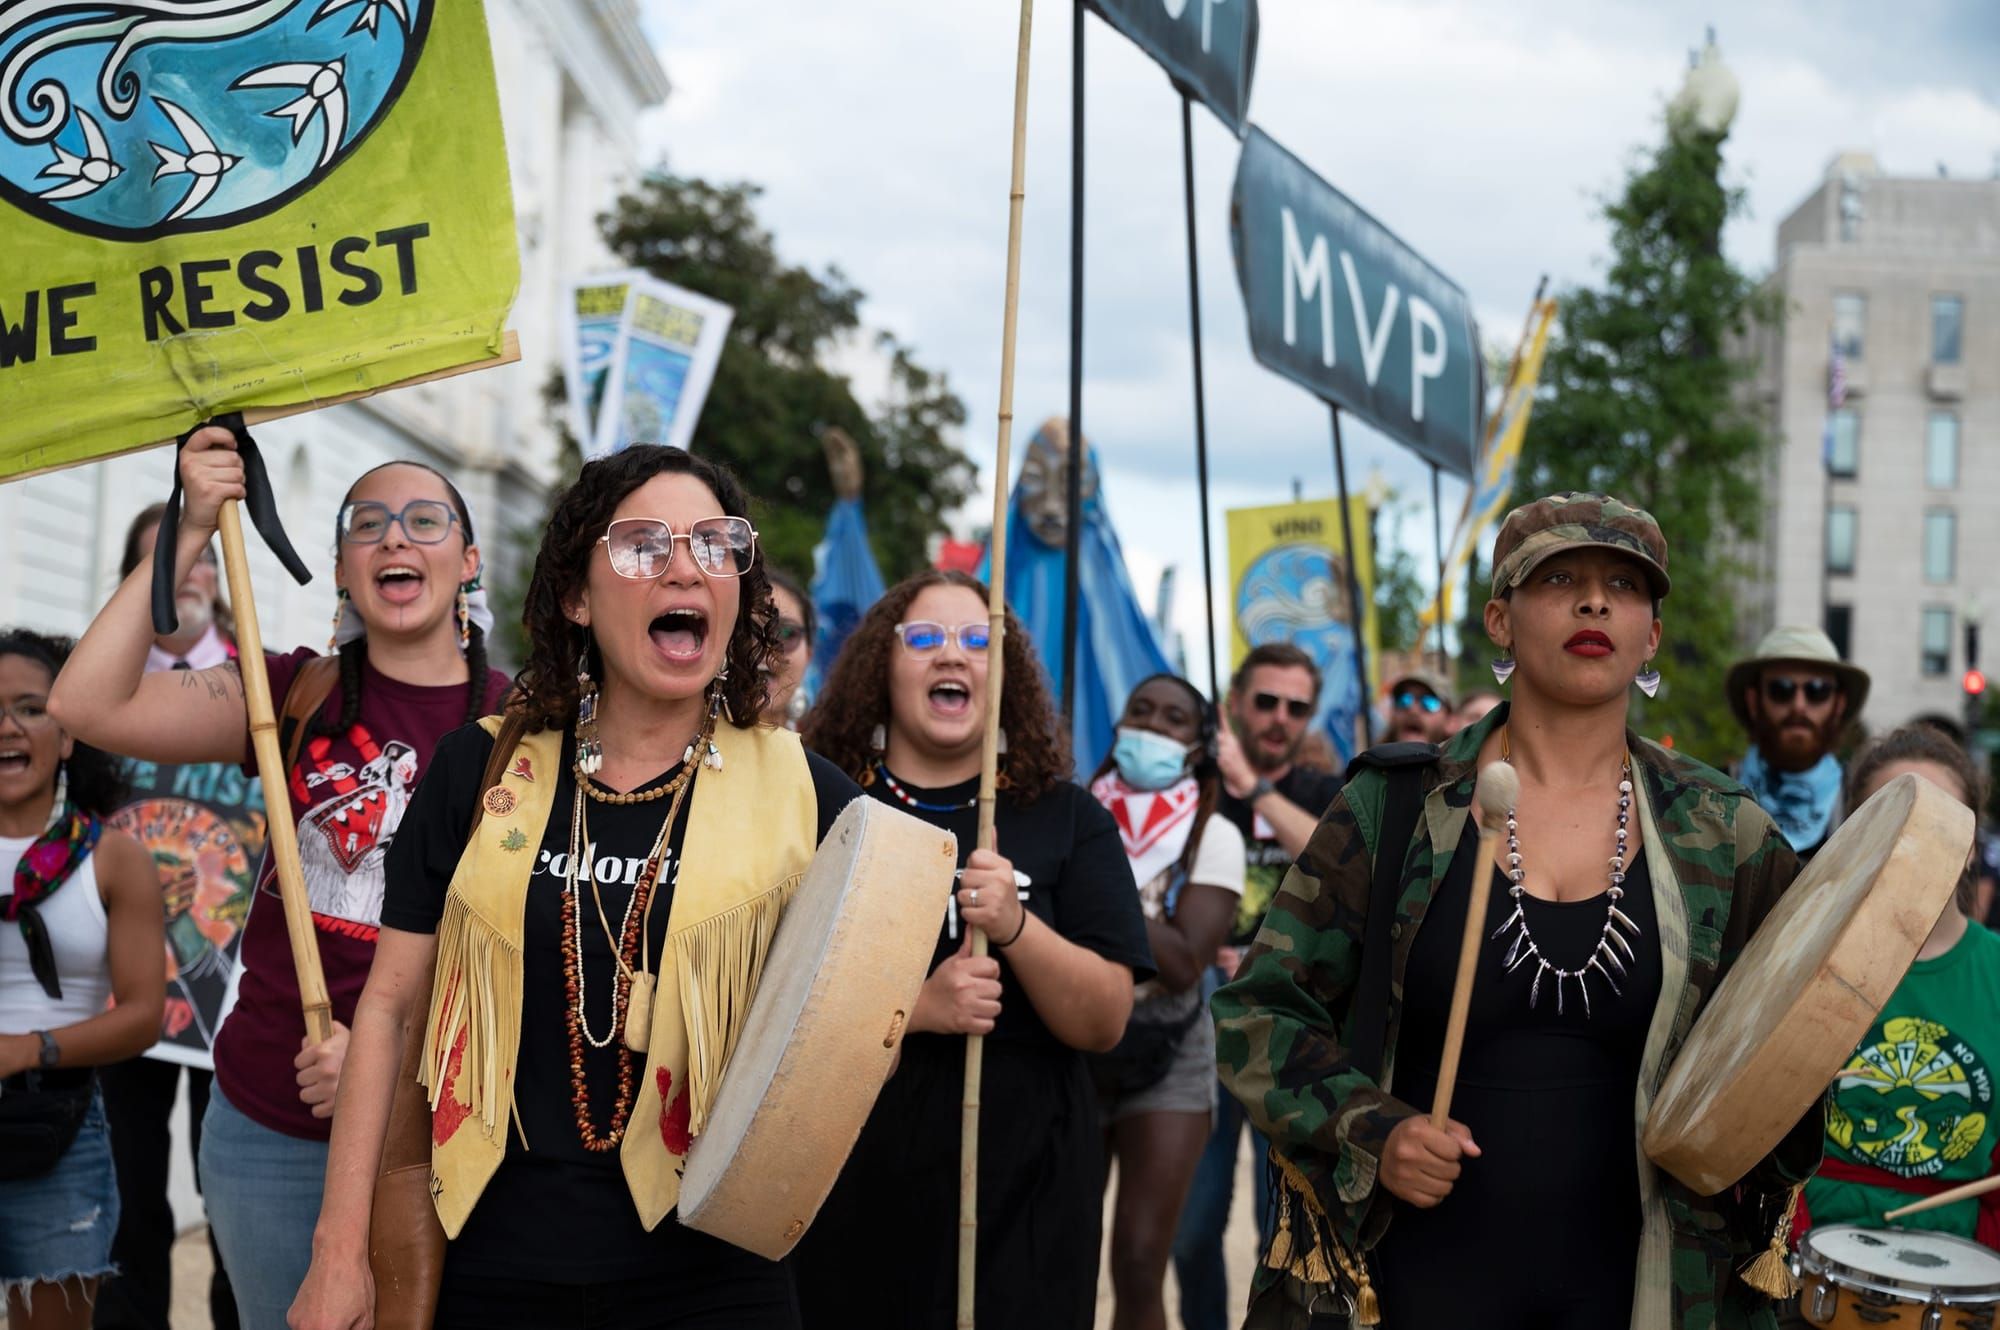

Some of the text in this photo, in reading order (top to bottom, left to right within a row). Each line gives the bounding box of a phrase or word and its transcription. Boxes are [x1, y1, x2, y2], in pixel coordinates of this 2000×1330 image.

[0, 222, 430, 368] WE RESIST
[1281, 206, 1448, 422] MVP
[531, 841, 680, 884] coloni
[1952, 1042, 1991, 1102] NO MVP
